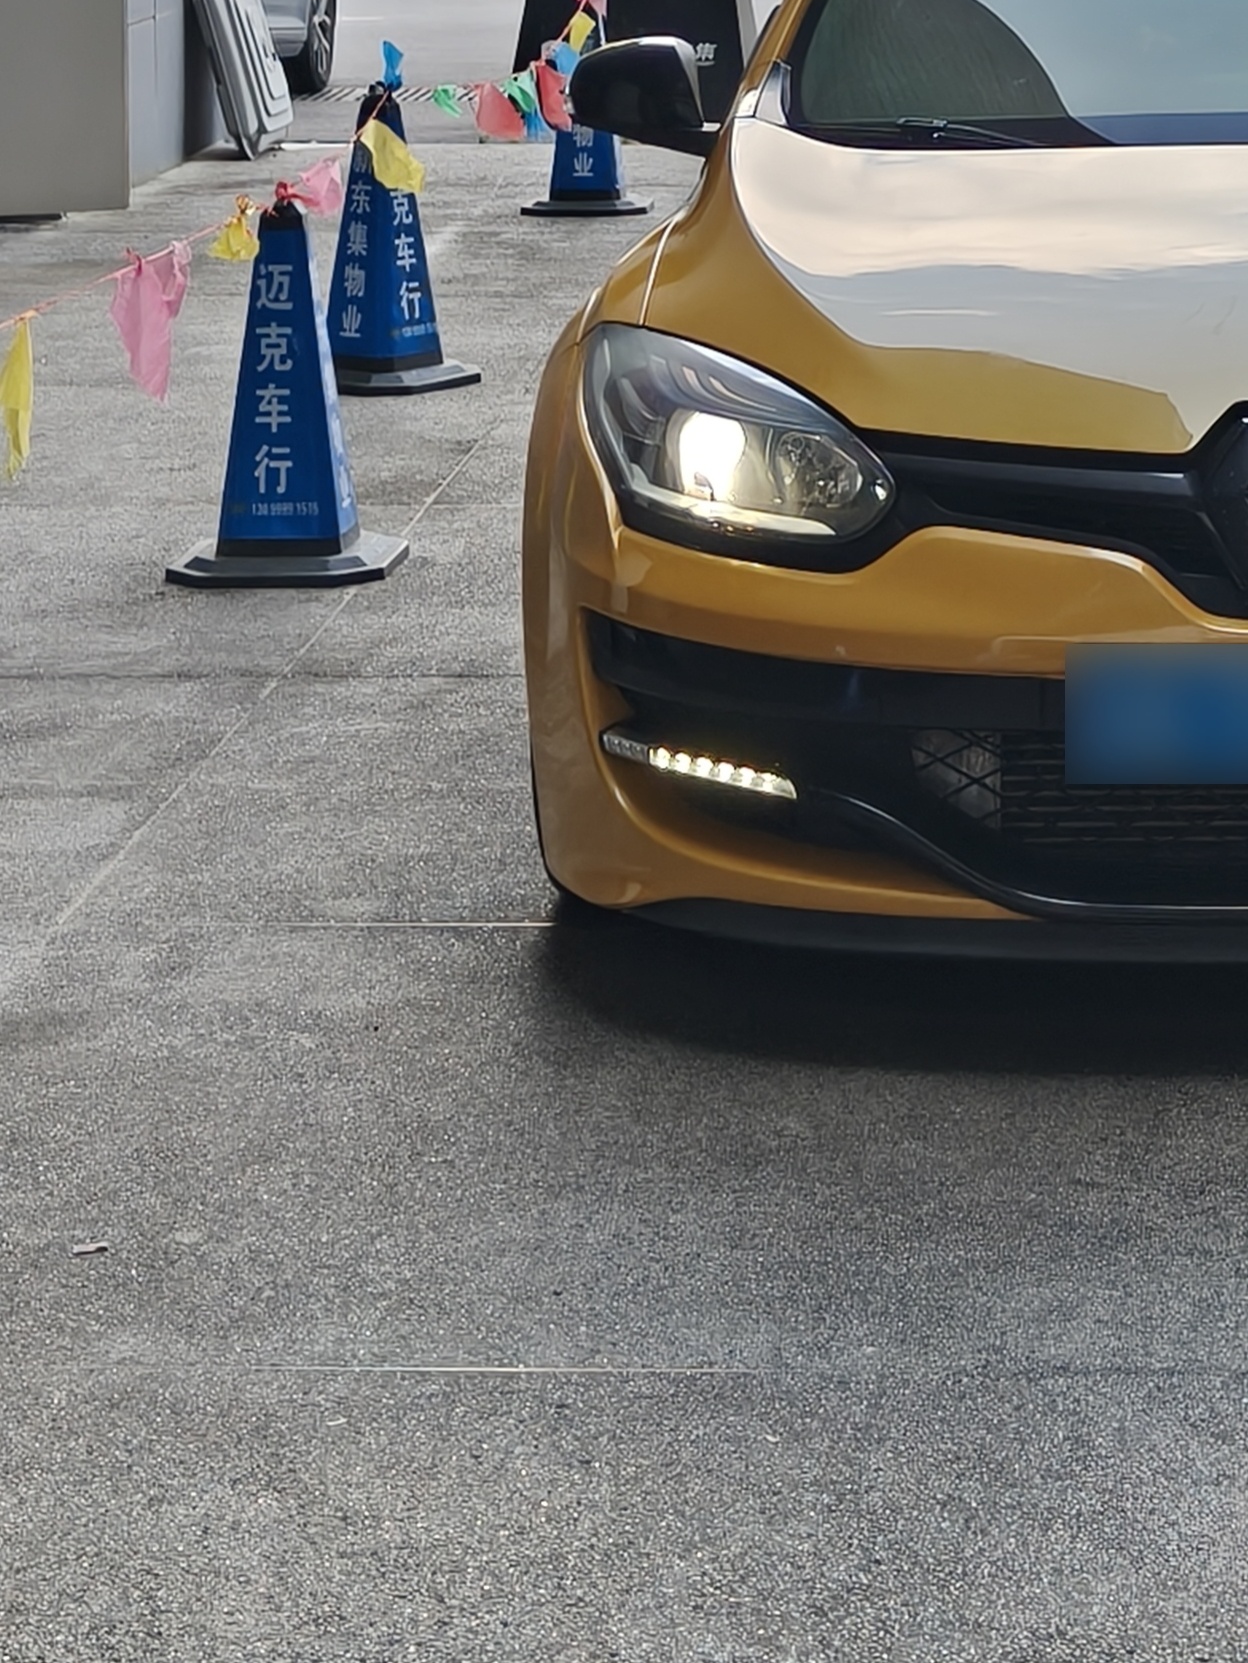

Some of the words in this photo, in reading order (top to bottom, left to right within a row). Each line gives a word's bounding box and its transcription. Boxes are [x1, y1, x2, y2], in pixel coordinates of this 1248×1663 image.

[390, 190, 421, 320] 克车行
[254, 264, 293, 495] 迈克车行
